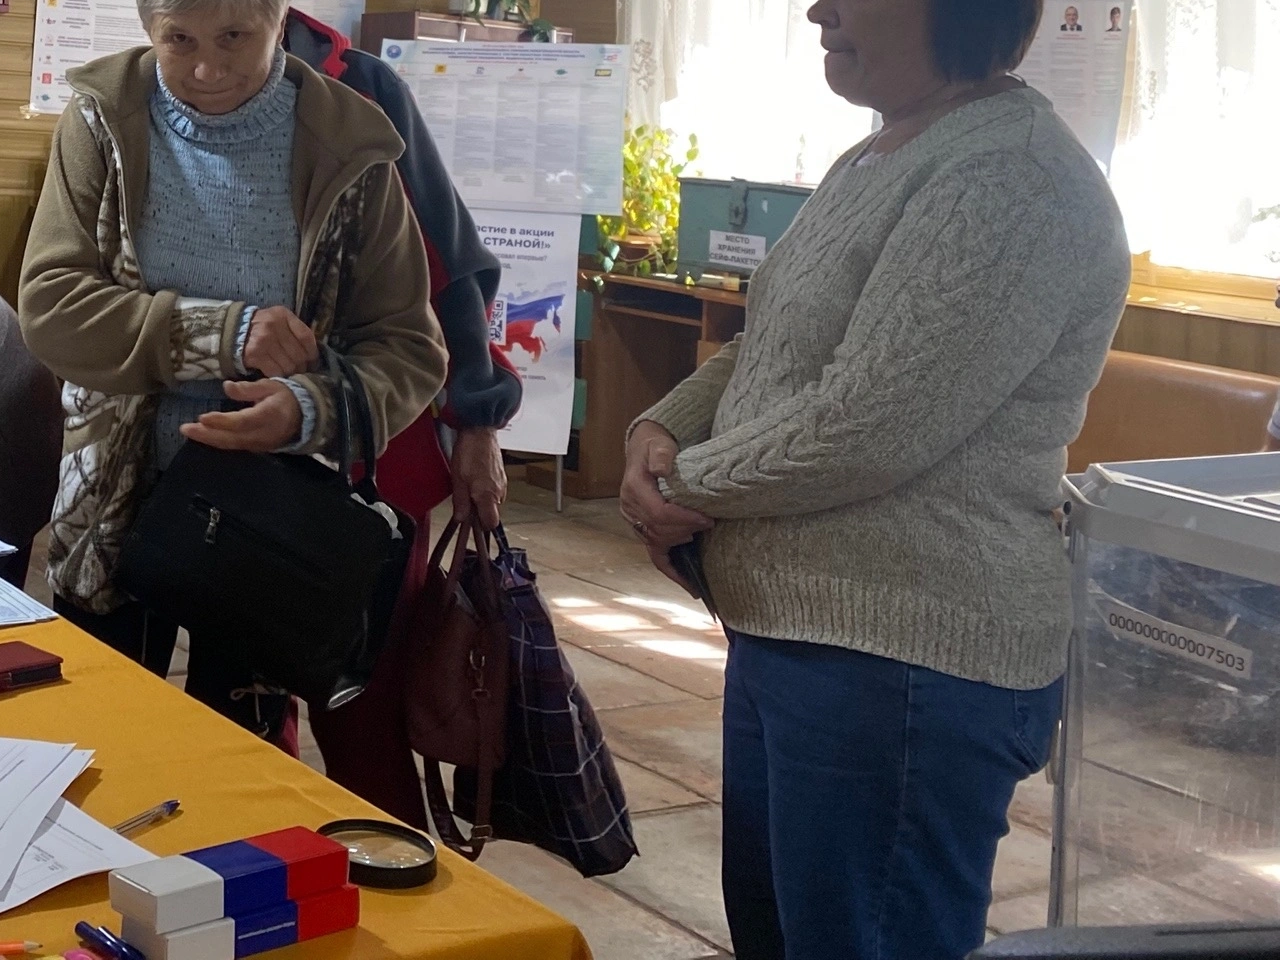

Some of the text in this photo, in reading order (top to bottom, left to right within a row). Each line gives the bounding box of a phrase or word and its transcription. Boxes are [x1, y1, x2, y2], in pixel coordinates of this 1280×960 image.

[476, 225, 554, 237] астие в акции
[483, 237, 551, 249] СТРАНОЙ!»
[726, 235, 750, 244] МЕСТО
[717, 243, 756, 255] ХРАНЕНИЯ
[1109, 613, 1245, 671] 000000000007503
